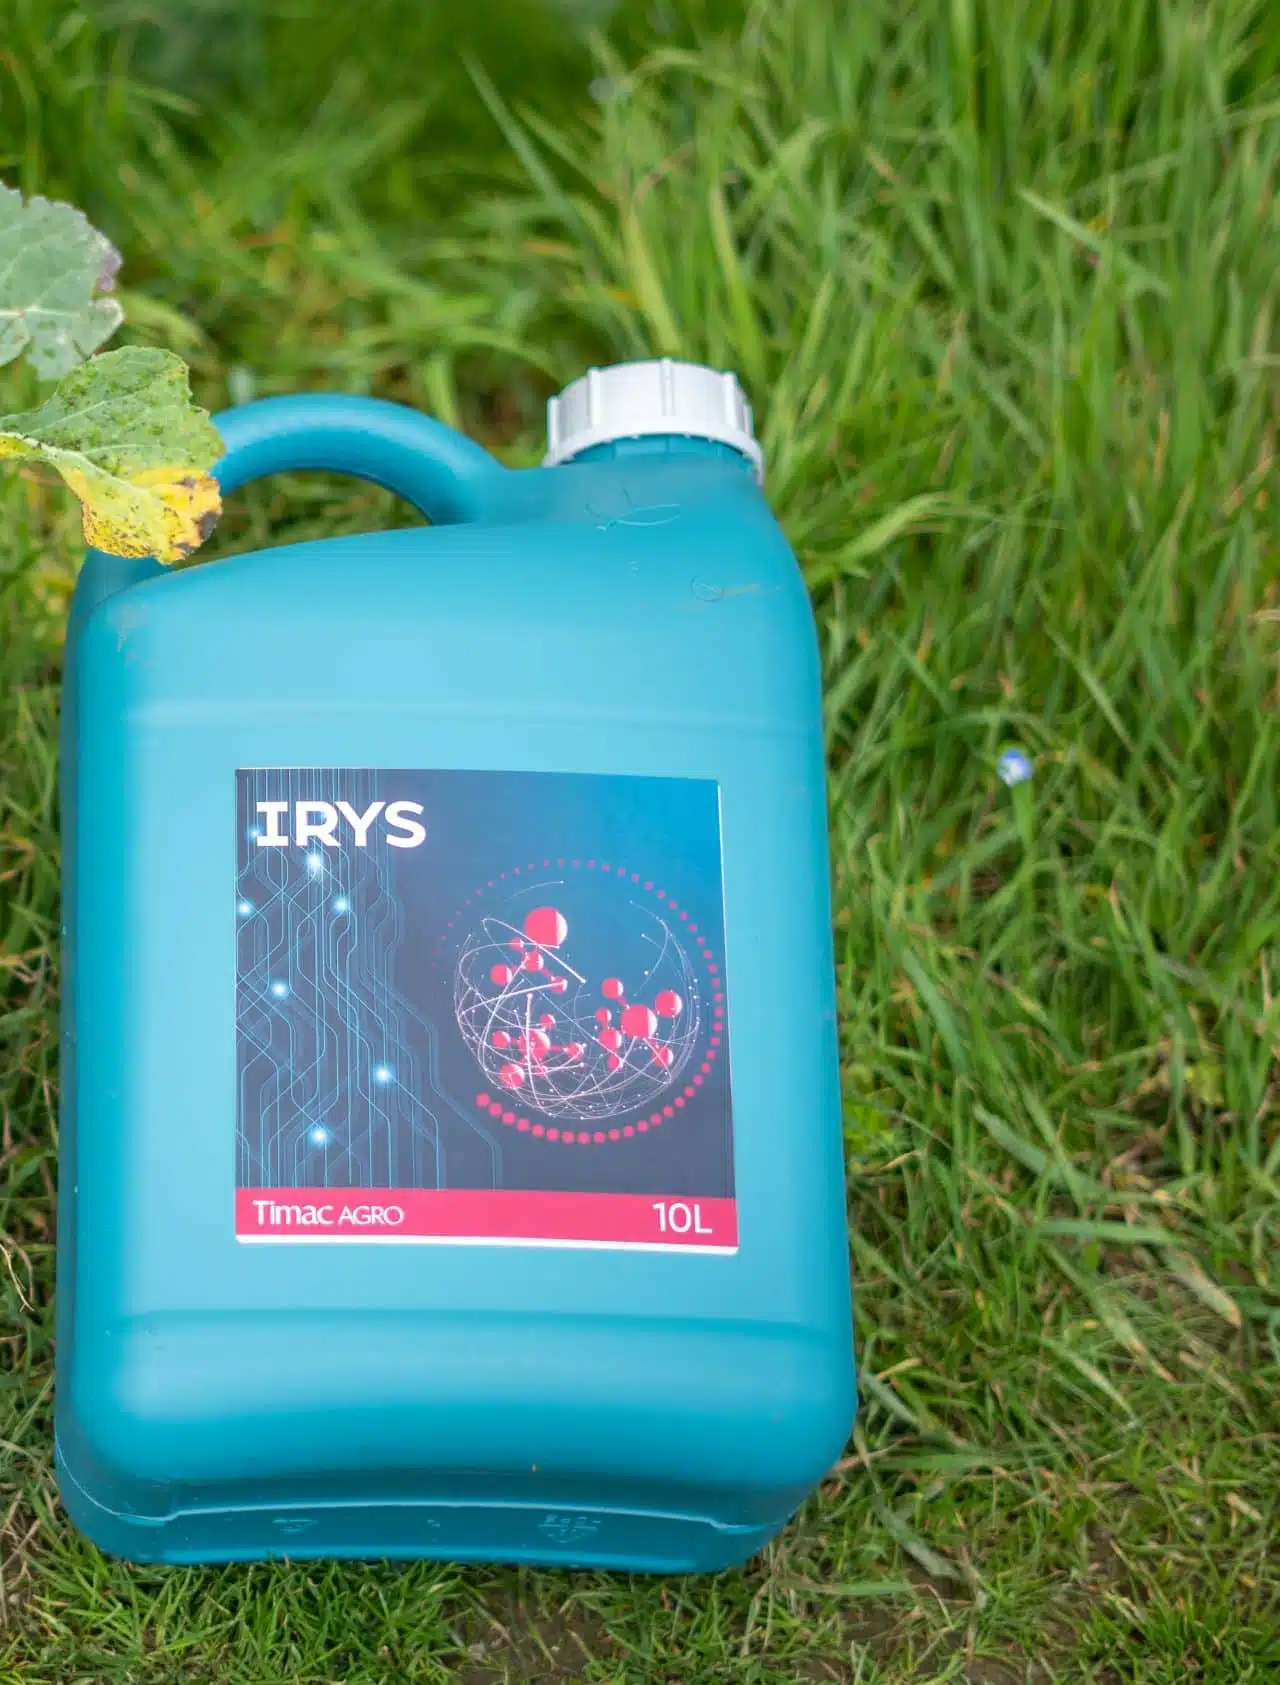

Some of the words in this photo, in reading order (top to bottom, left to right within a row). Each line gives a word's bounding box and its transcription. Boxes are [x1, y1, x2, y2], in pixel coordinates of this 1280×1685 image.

[256, 800, 427, 848] IRYS
[252, 1200, 334, 1225] Timac
[337, 1205, 405, 1225] AGRO
[652, 1202, 713, 1234] 10L
